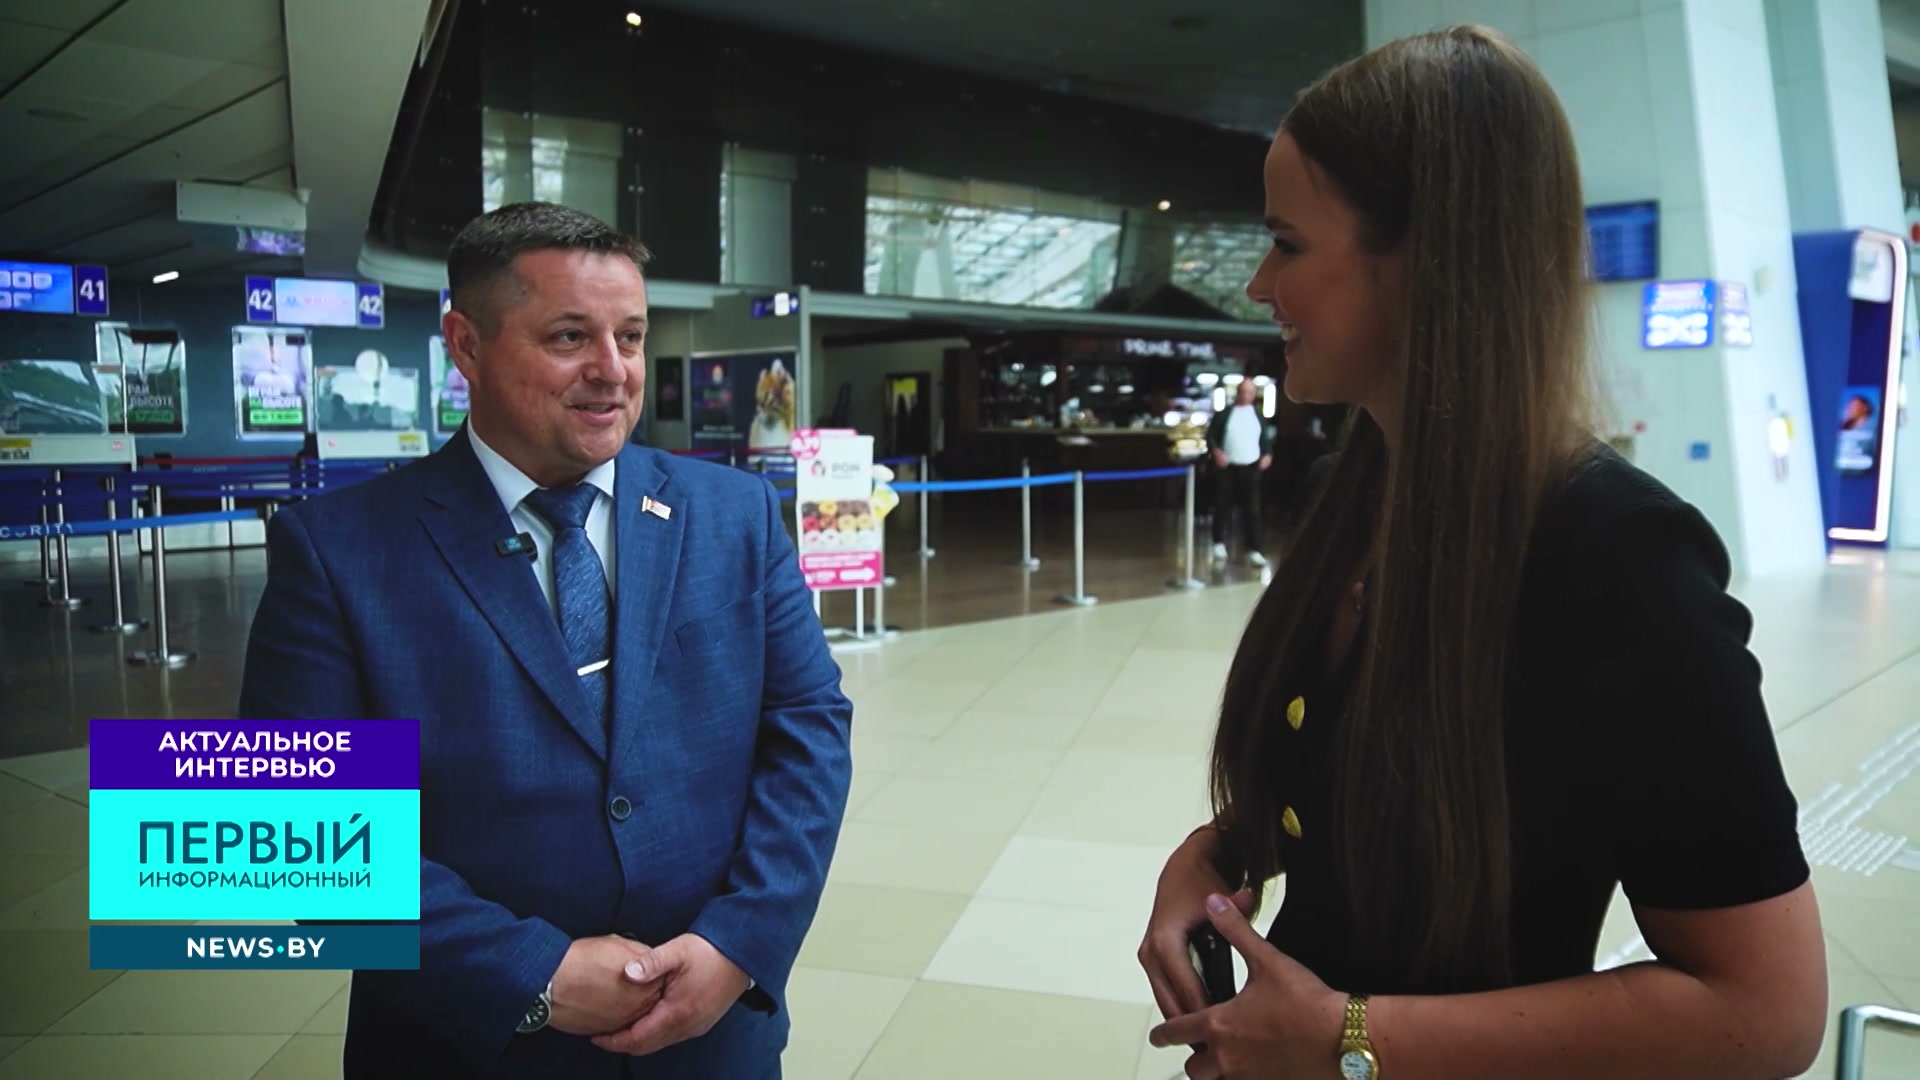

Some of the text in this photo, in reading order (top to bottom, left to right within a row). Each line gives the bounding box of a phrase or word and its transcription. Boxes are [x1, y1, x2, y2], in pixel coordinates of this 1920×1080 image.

[80, 279, 105, 301] 41
[249, 288, 273, 311] 42
[359, 295, 381, 316] 42
[1124, 338, 1216, 359] PRIME TIME
